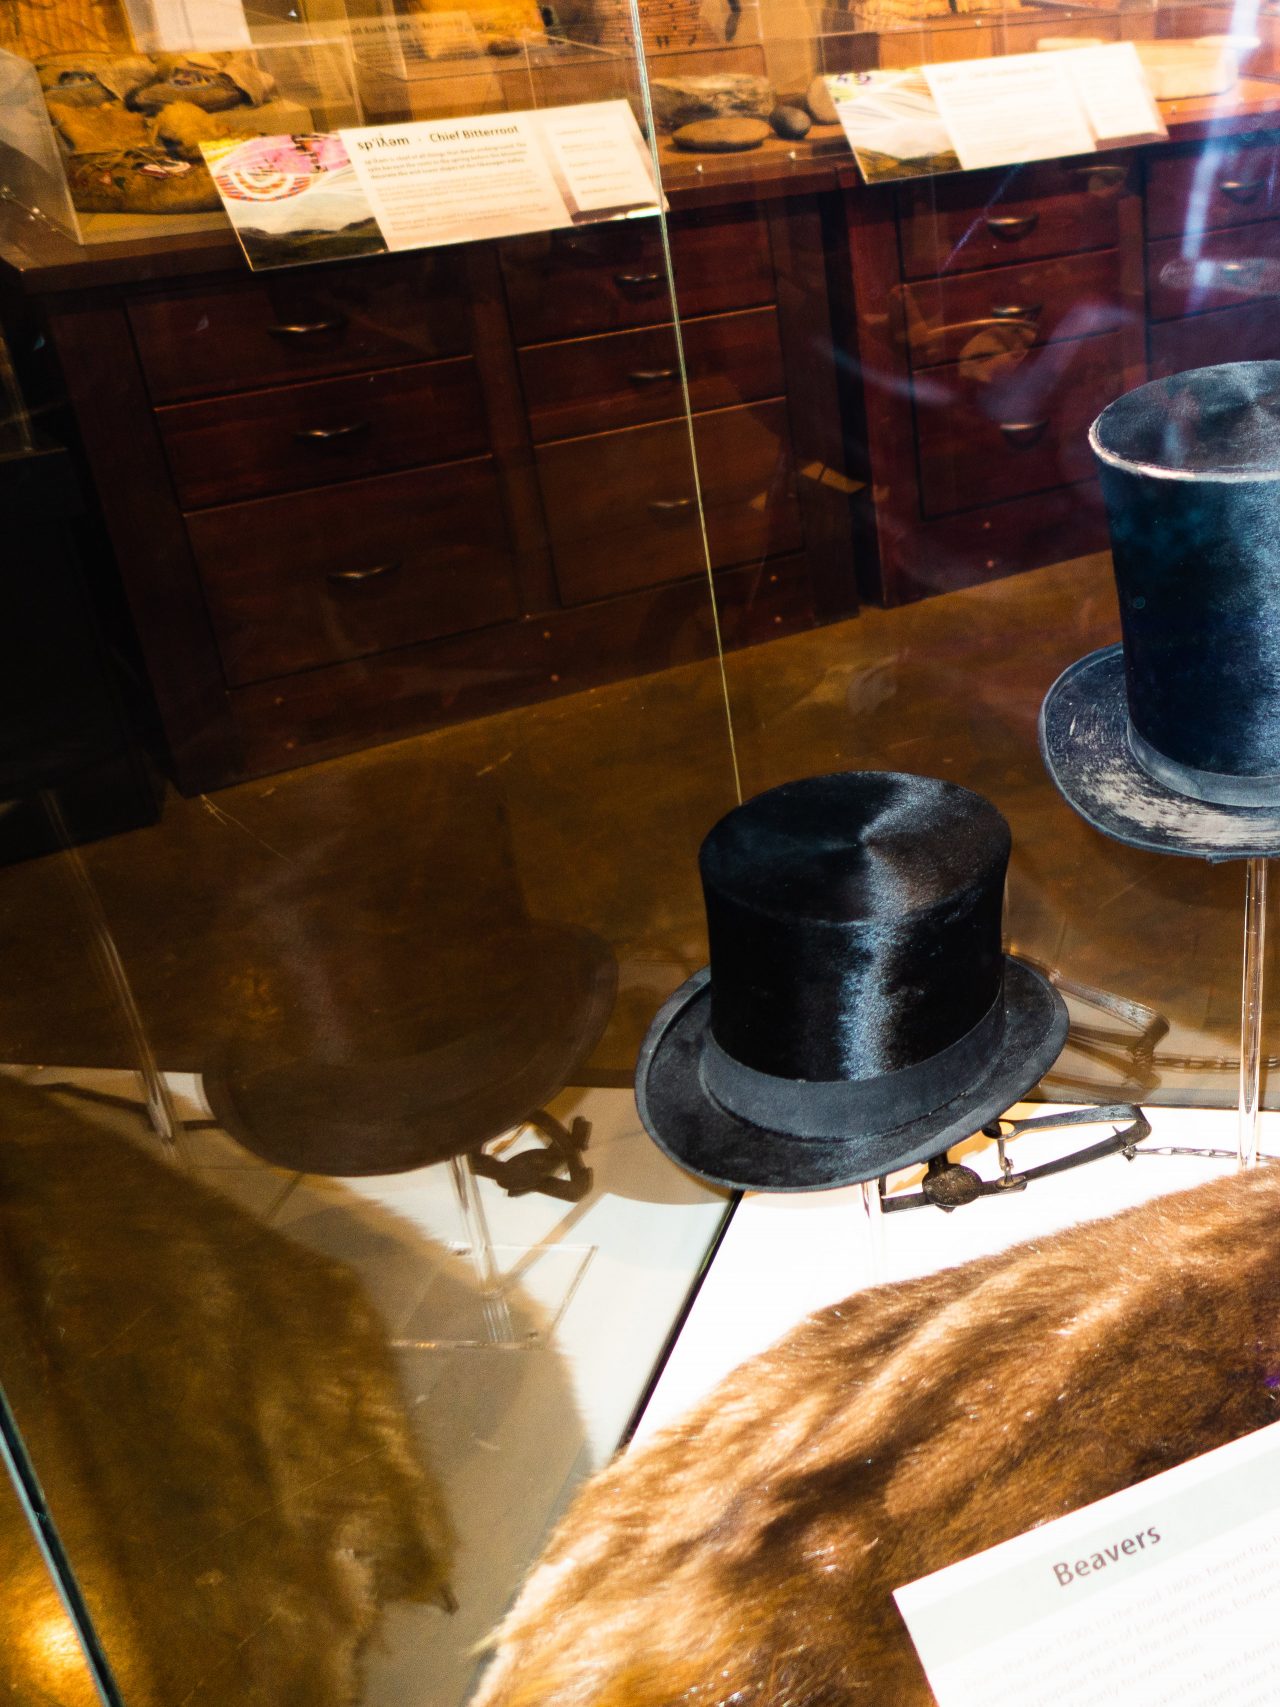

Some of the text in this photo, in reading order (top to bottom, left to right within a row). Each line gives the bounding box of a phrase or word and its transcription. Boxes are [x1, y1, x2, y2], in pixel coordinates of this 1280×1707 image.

[430, 132, 460, 144] Chief
[463, 125, 520, 140] Bitterroot
[1052, 1523, 1163, 1588] Beavers
[1094, 1613, 1112, 1630] to
[1110, 1602, 1135, 1622] the
[1116, 1626, 1134, 1643] of
[1132, 1597, 1198, 1638] European
[1137, 1636, 1161, 1655] the
[1200, 1655, 1241, 1682] North
